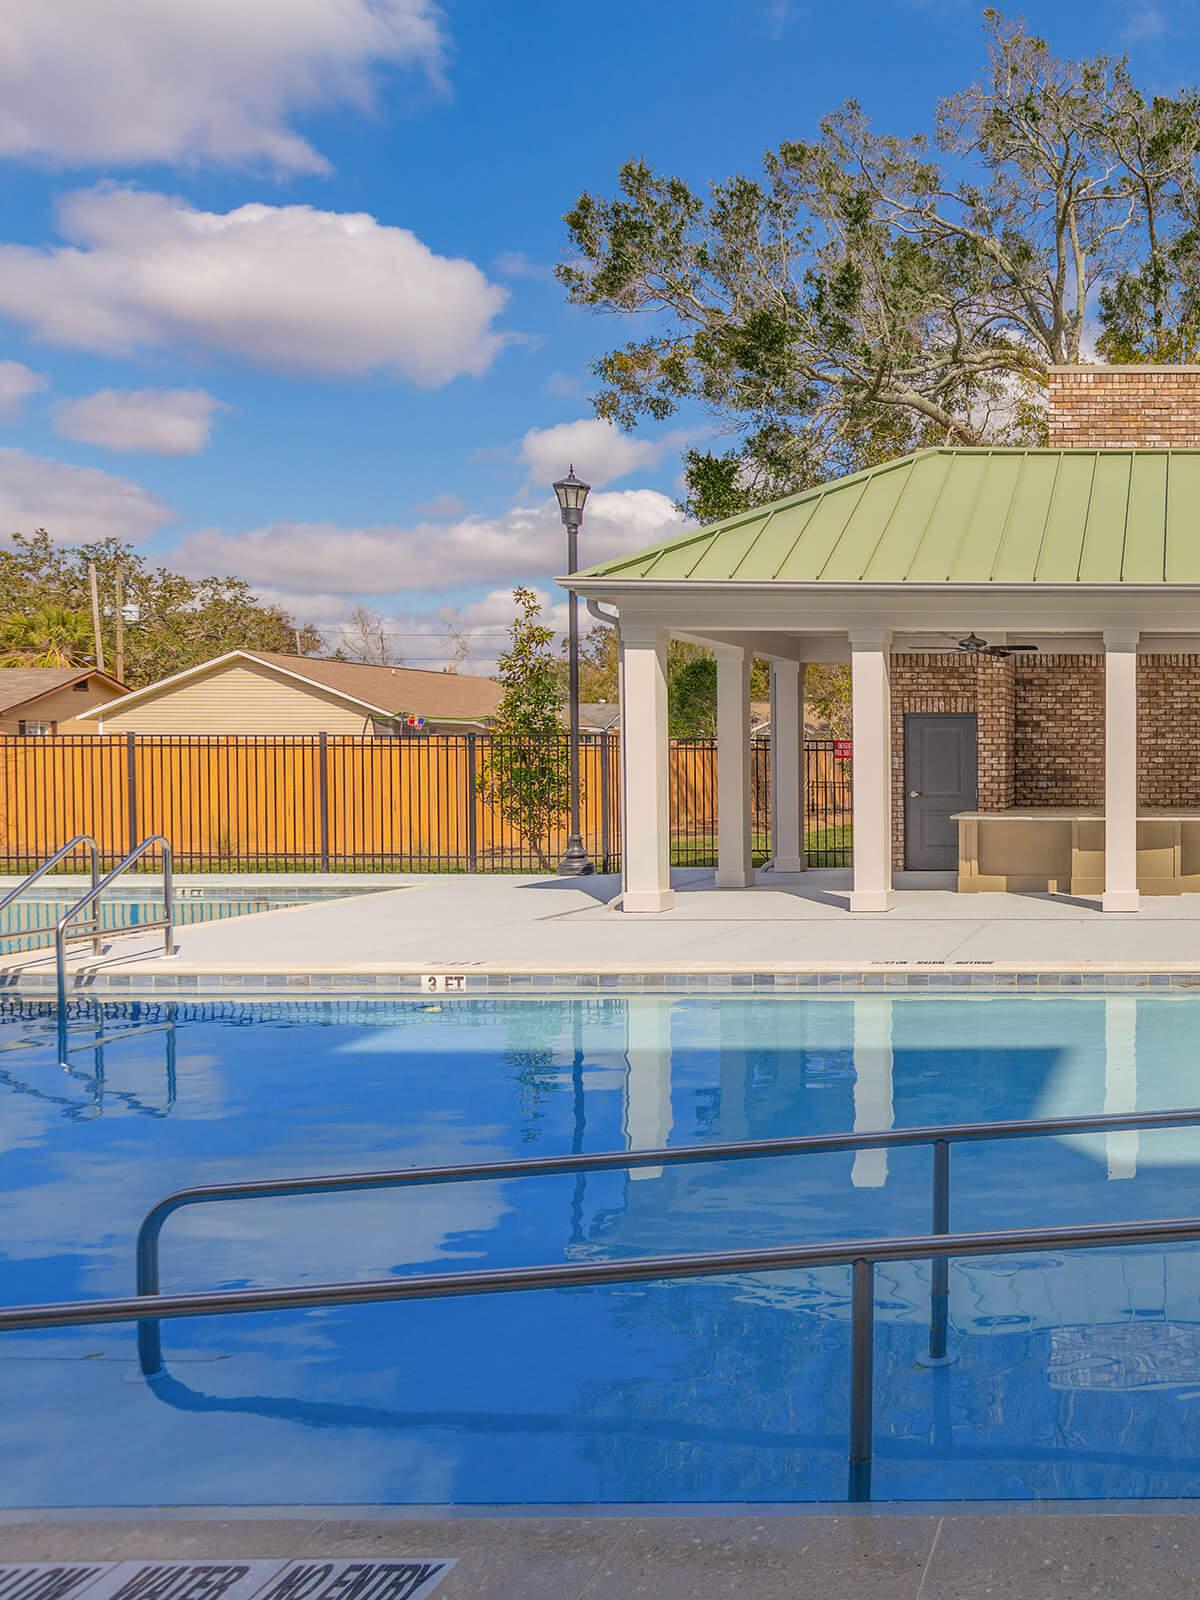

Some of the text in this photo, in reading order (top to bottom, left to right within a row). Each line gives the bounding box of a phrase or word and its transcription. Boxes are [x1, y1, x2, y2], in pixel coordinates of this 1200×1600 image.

[444, 976, 464, 987] FT
[109, 1566, 250, 1600] WATER
[262, 1564, 335, 1600] NO
[318, 1564, 447, 1600] ENTRY
